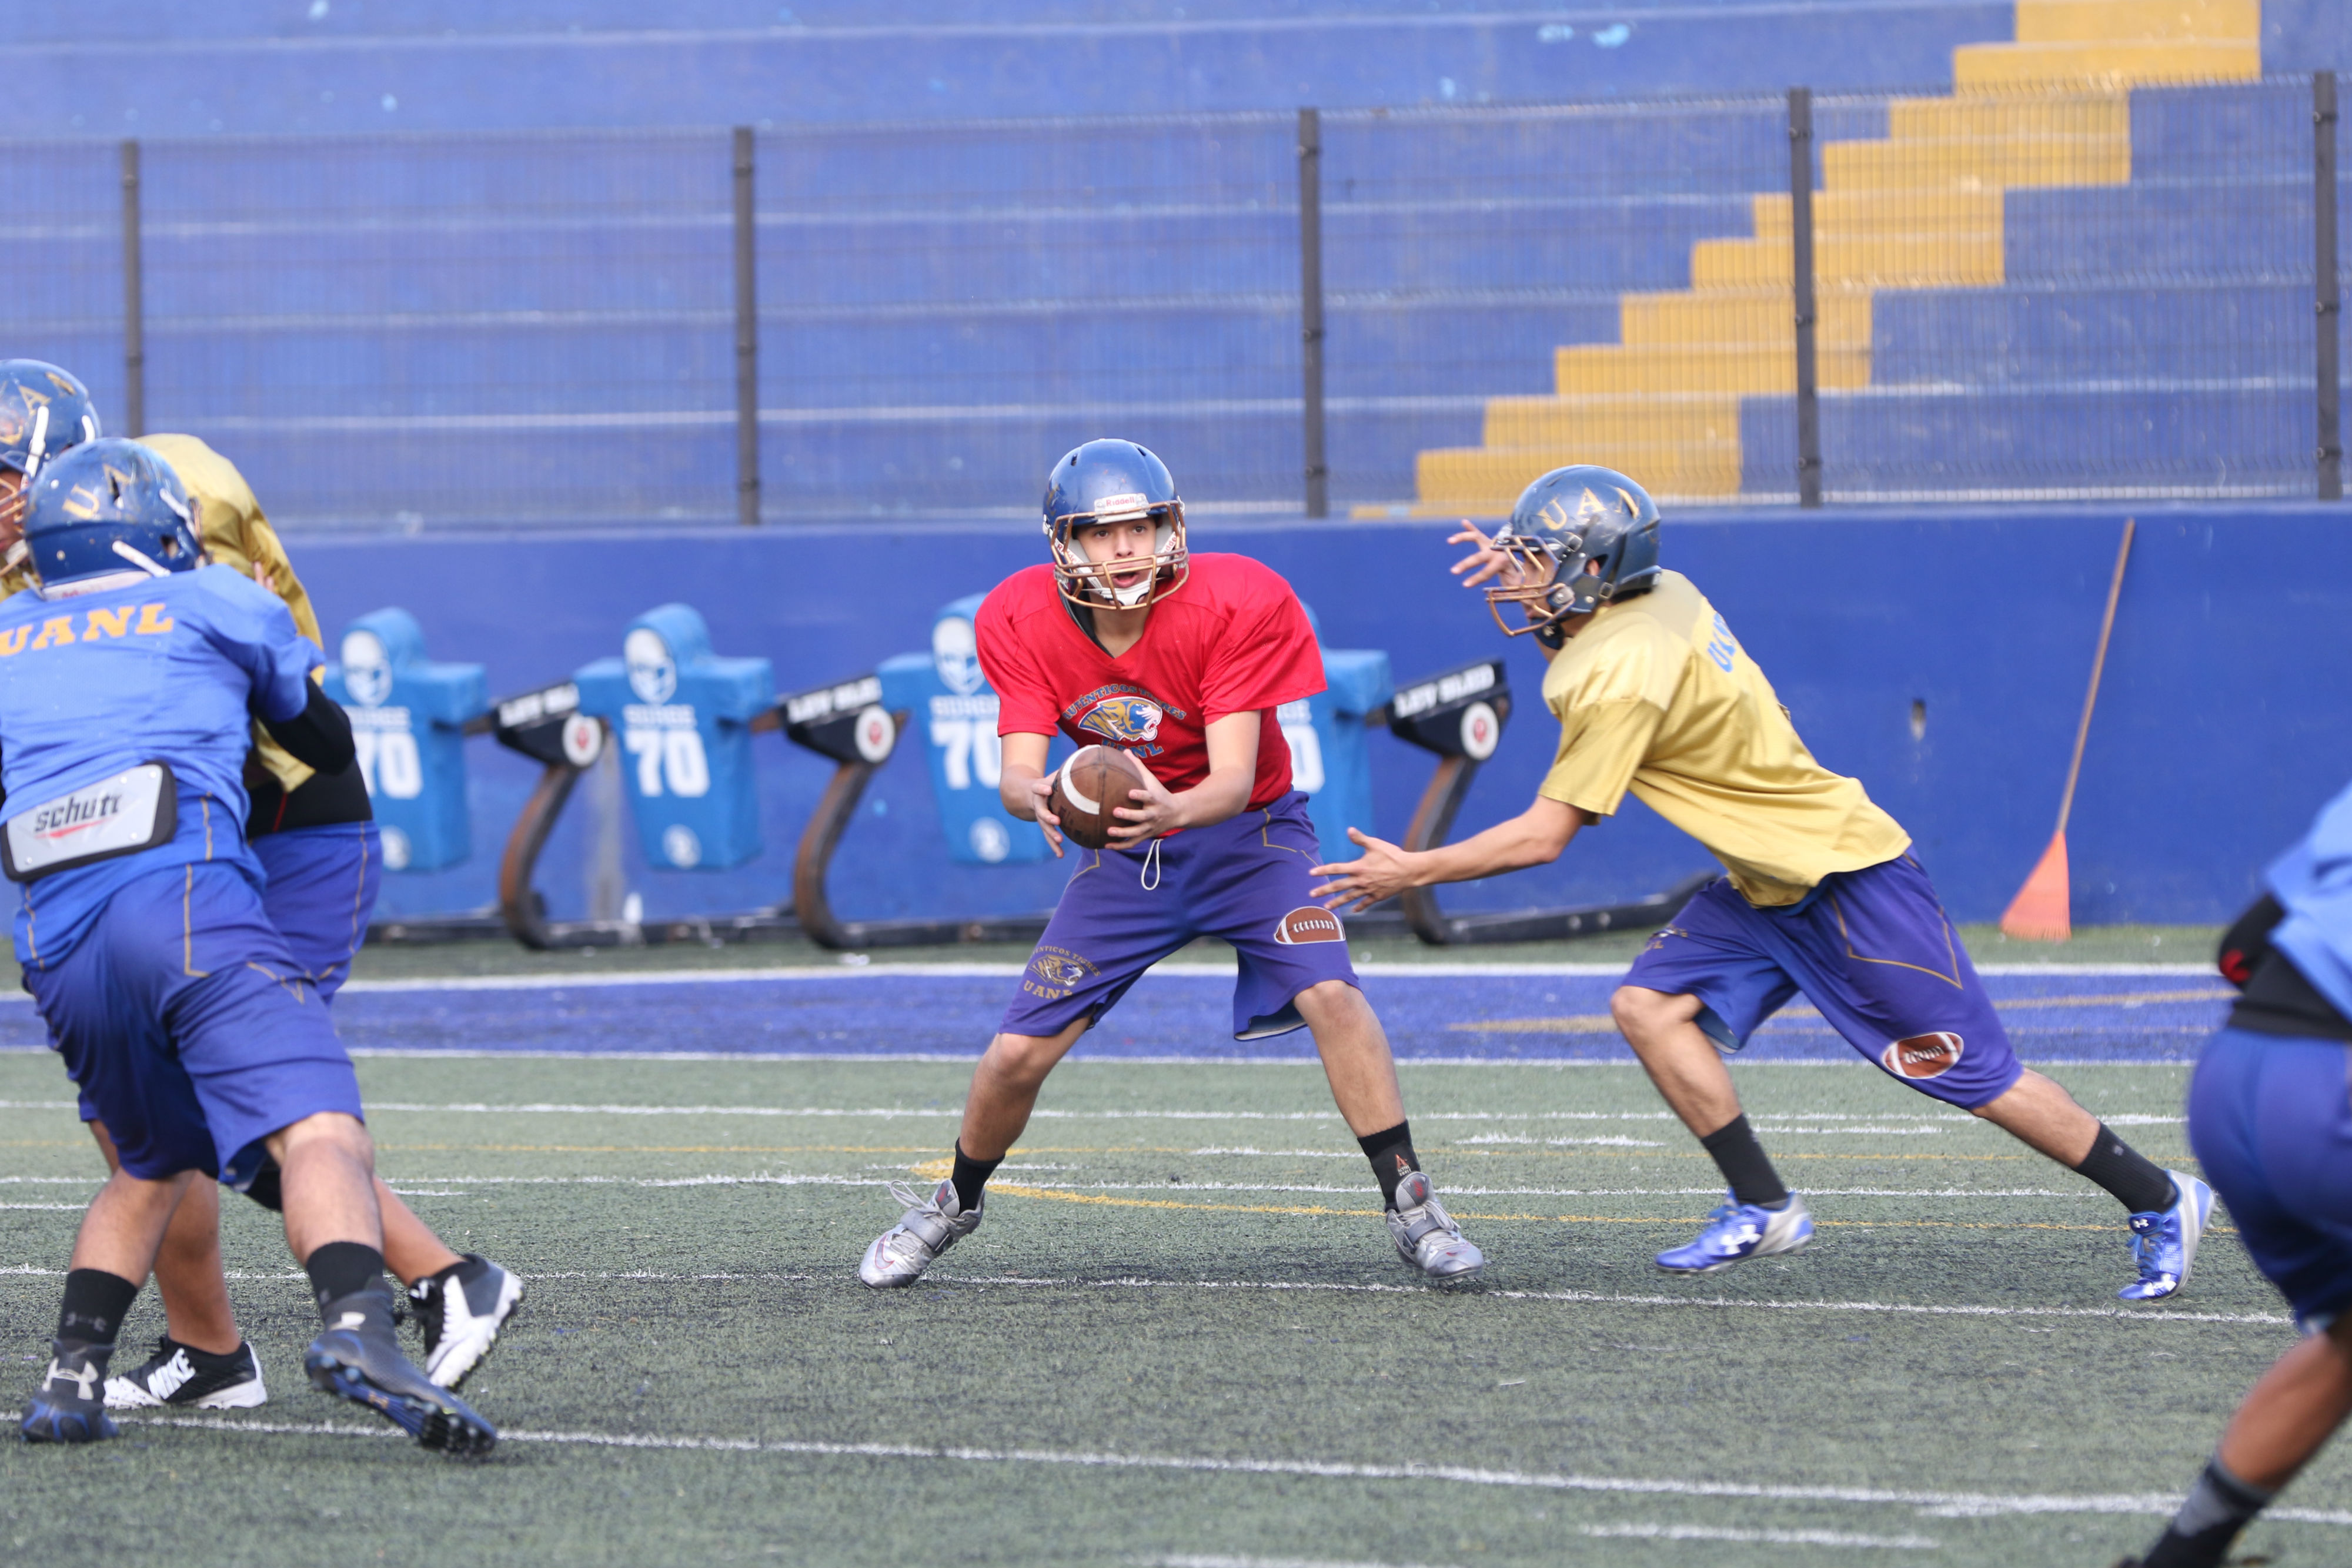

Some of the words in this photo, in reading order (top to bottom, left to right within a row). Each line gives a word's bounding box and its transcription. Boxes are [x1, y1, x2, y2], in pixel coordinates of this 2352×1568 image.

[1106, 497, 1135, 507] Riddell
[0, 603, 173, 657] UANL
[624, 730, 711, 798] 70
[929, 721, 1002, 788] 70
[148, 1348, 196, 1400] NIKE
